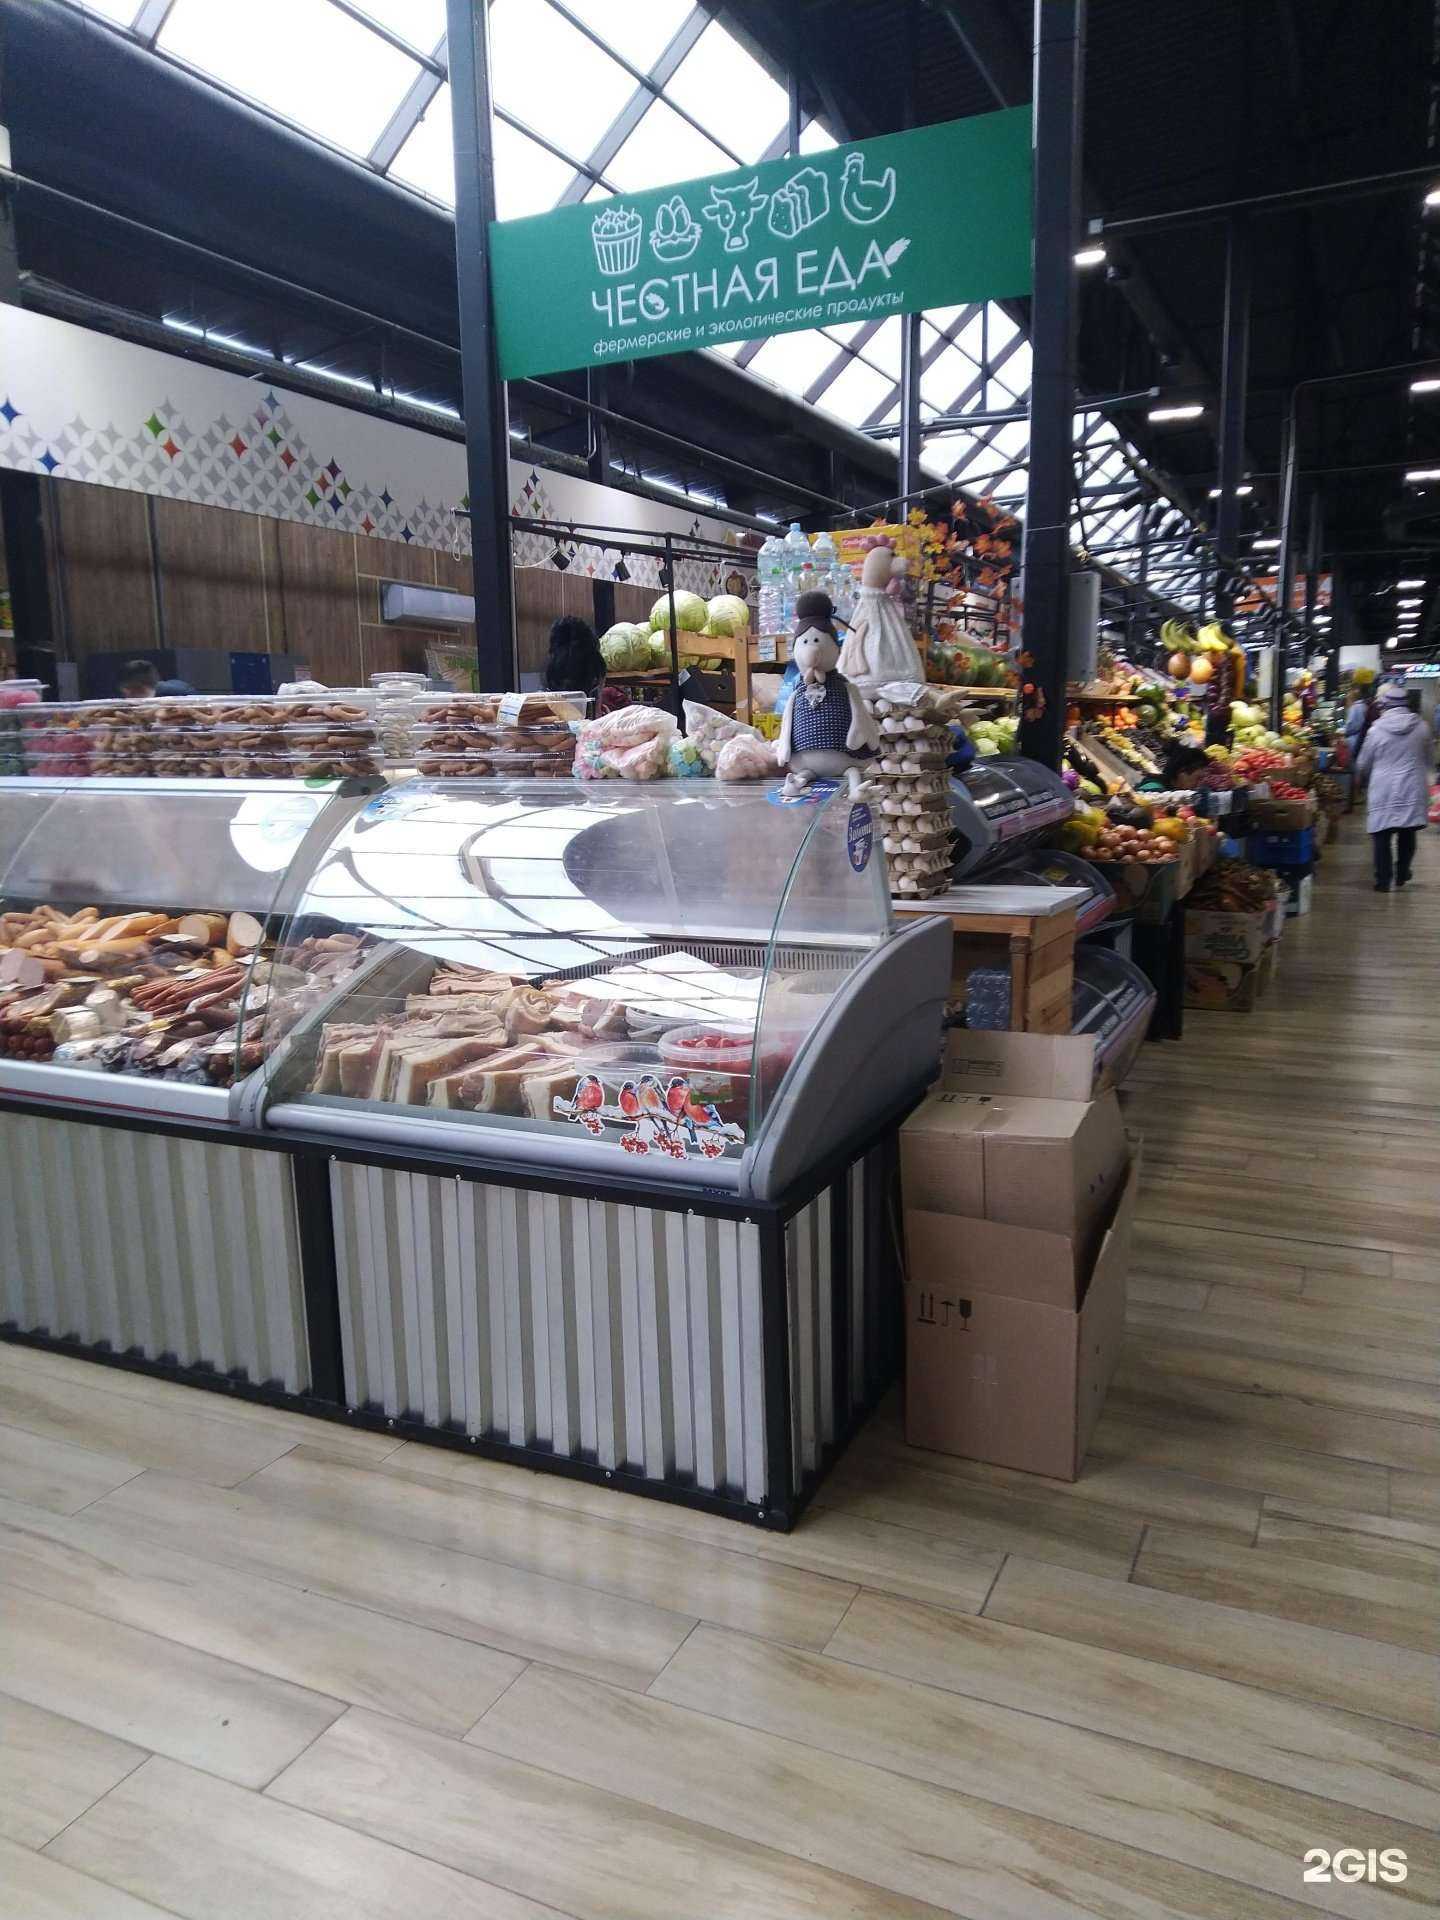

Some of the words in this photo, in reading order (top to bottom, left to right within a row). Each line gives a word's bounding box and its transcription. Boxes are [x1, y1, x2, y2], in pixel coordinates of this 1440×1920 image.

[592, 257, 778, 327] ЧЕСТНАЯ
[796, 239, 892, 296] ЕДА
[593, 326, 692, 357] фермерские
[695, 325, 706, 338] и
[708, 304, 823, 336] экологические
[826, 291, 905, 317] продукты
